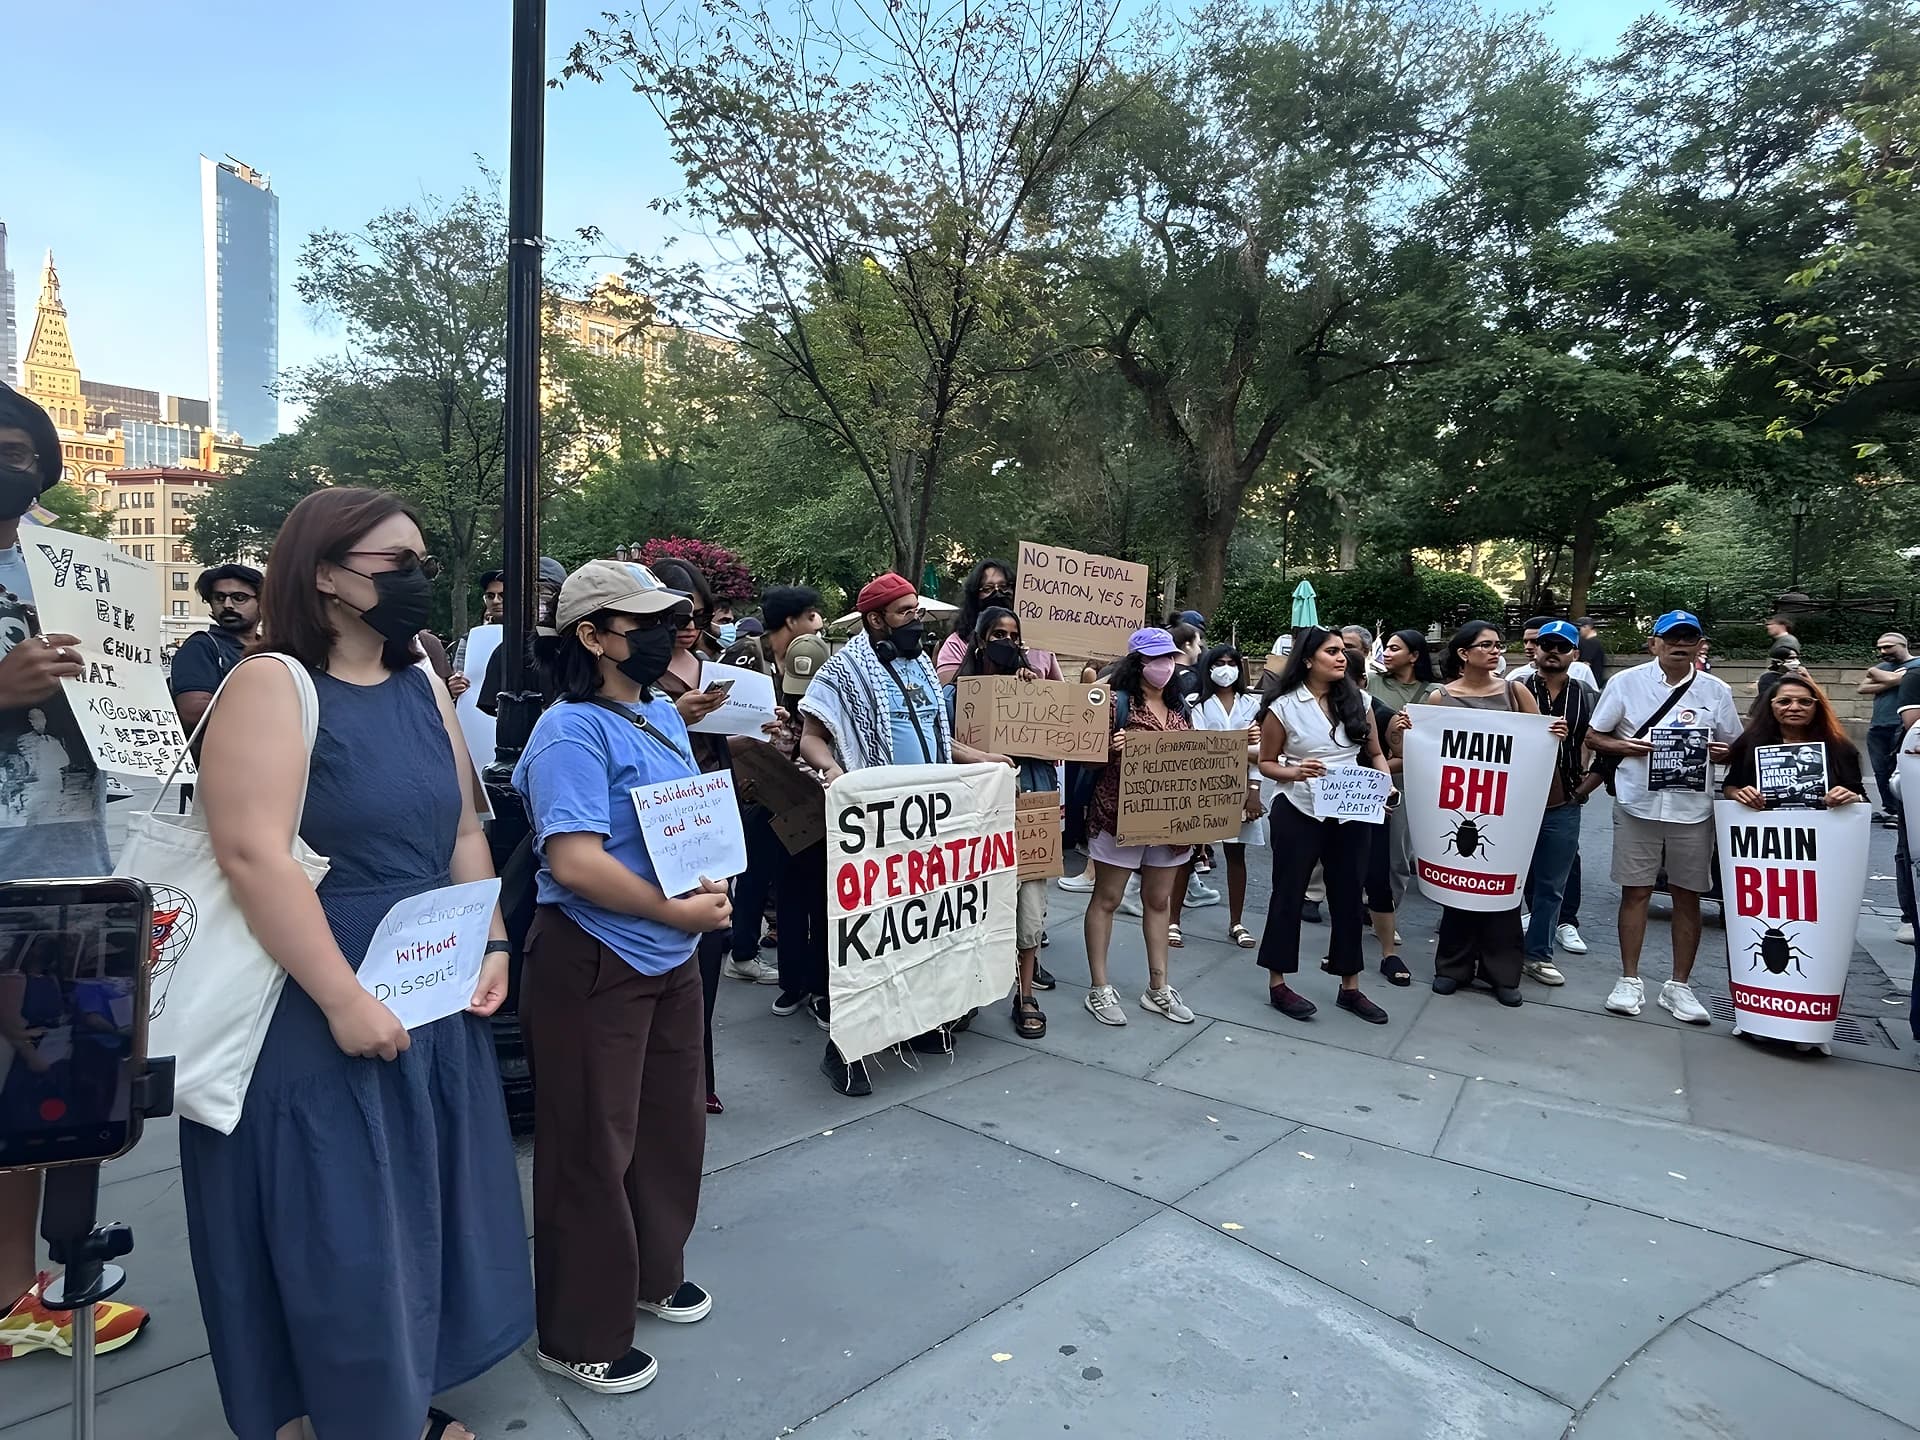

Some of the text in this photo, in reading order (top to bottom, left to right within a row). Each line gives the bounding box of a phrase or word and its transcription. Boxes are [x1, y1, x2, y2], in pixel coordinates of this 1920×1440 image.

[37, 543, 111, 593] YEH
[1024, 548, 1133, 582] NO TO FEUDAL
[1023, 574, 1144, 609] EDUCATION, YES TO
[1019, 600, 1043, 619] PRO
[1084, 611, 1143, 629] EDUCATION
[103, 637, 152, 664] CHUKI
[960, 679, 981, 696] TO
[1023, 682, 1056, 702] OUR
[996, 696, 1077, 723] FUTURE
[955, 722, 1106, 753] WE MUST RESIST!
[1124, 738, 1151, 758] EACH
[1440, 729, 1513, 765] MAIN
[1124, 761, 1138, 776] OF
[1143, 759, 1190, 774] RELATIVE
[1652, 759, 1684, 770] MINDS
[635, 777, 729, 811] In Solidarity with
[1124, 779, 1177, 795] DISCOVER
[1177, 779, 1197, 792] ITS
[1367, 779, 1378, 790] TO
[1439, 765, 1509, 817] BHI
[1762, 776, 1798, 788] MINDS
[663, 818, 685, 837] and
[694, 813, 712, 826] the
[838, 792, 952, 855] STOP
[1730, 825, 1817, 861] MAIN
[836, 831, 1015, 912] OPERATION
[1424, 867, 1506, 891] COCKROACH
[1734, 865, 1818, 922] BHI
[838, 880, 988, 967] KAGAR!
[396, 931, 457, 965] without
[1735, 990, 1831, 1016] COCKROACH
